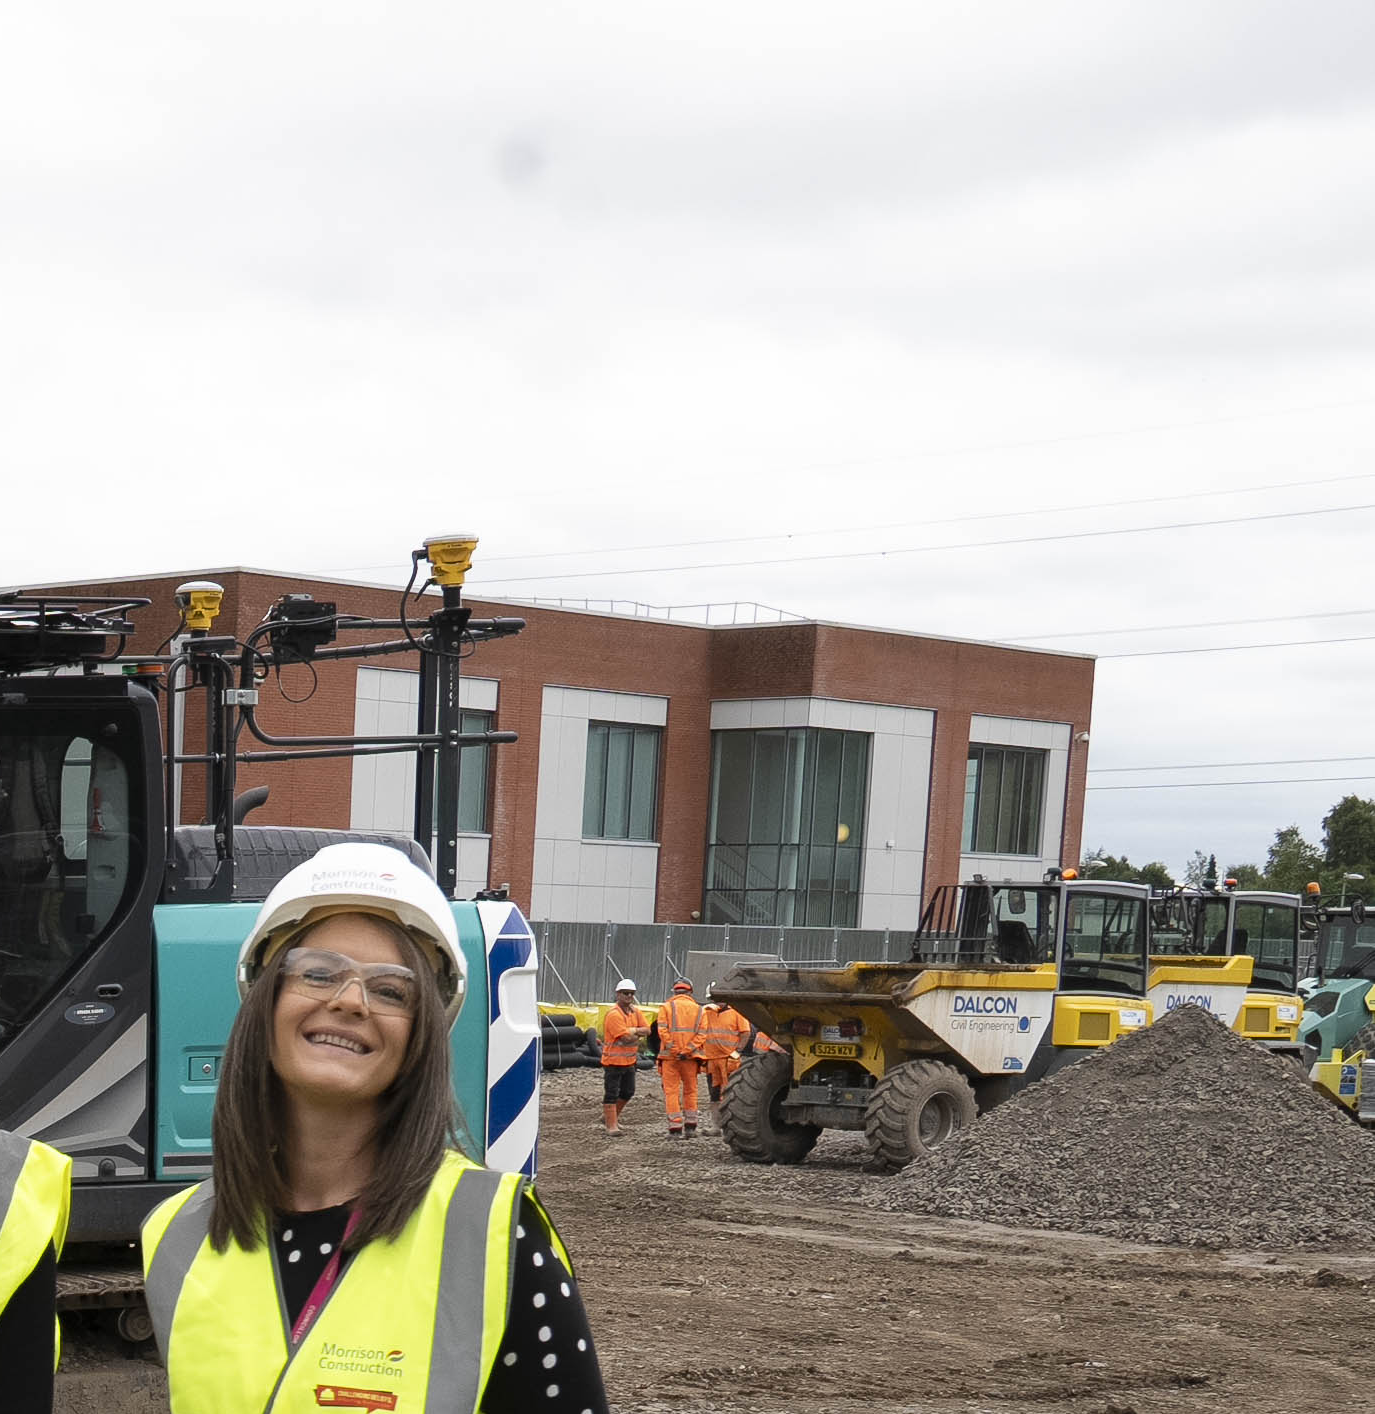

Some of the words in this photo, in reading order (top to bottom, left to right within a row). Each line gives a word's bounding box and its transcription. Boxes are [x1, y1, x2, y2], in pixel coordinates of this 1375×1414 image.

[312, 870, 378, 881] Morrison
[311, 880, 397, 894] Construction
[953, 995, 1018, 1014] DALCON
[951, 1019, 967, 1030] Civil
[969, 1020, 1015, 1033] Engineering
[321, 1342, 385, 1361] Morrison
[318, 1356, 403, 1378] Construction
